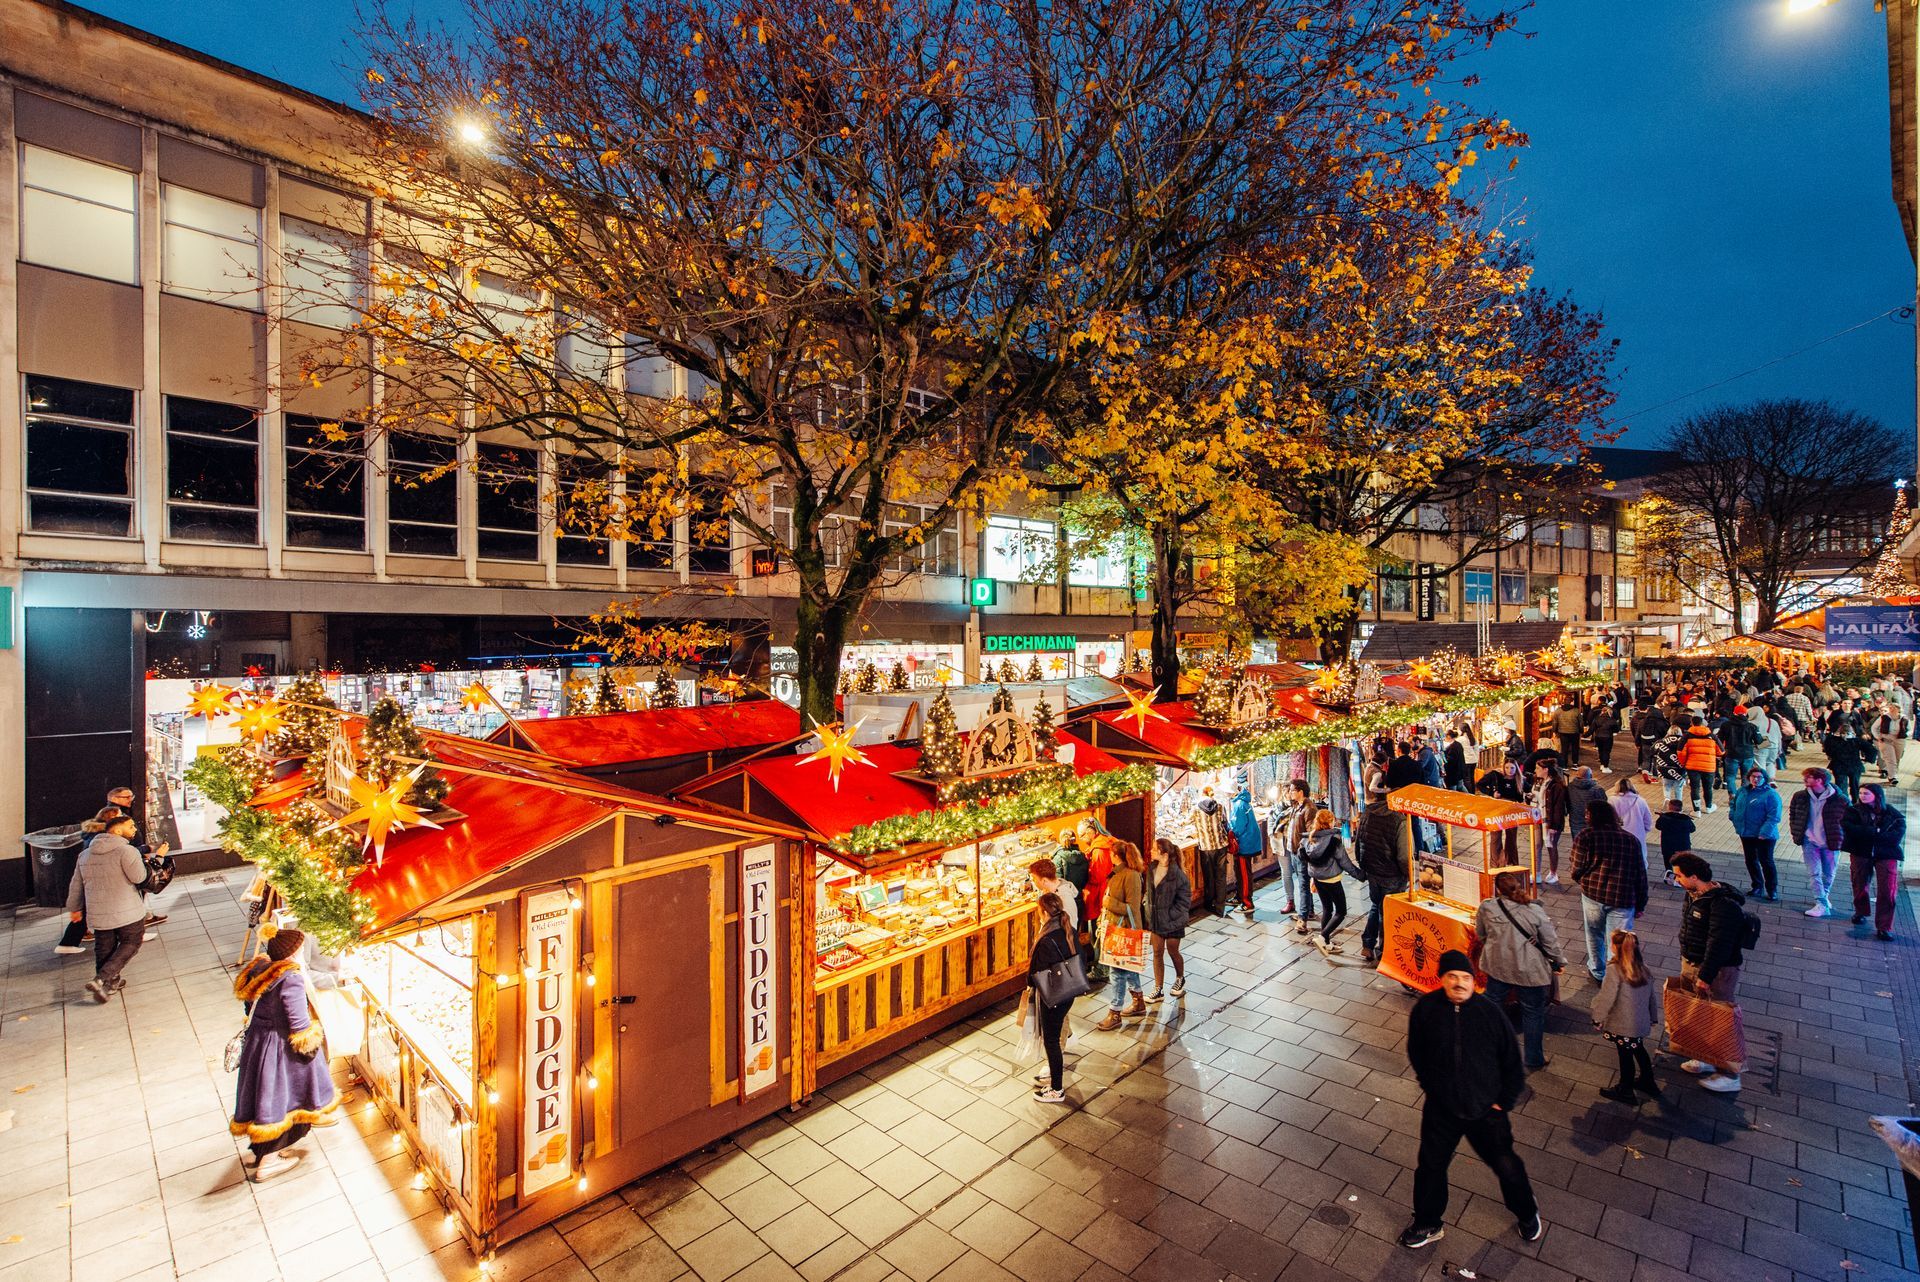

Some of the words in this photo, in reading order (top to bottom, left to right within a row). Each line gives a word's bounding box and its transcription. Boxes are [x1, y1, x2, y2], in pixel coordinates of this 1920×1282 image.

[756, 560, 775, 574] hmv
[975, 583, 990, 601] D
[1421, 578, 1430, 618] Martens
[1828, 623, 1920, 635] HALIFAX
[986, 635, 1076, 651] DEICHMANN
[1391, 796, 1403, 807] LIP
[1404, 799, 1411, 807] &
[1411, 801, 1436, 815] BODY
[1437, 807, 1464, 818] BALM
[1485, 817, 1504, 826] RAW
[1505, 812, 1532, 822] HONEY
[534, 909, 567, 922] MILLY'S
[1393, 912, 1428, 933] AMAZING
[1429, 923, 1448, 950] BEES
[750, 881, 769, 1045] FUDGE
[1394, 948, 1404, 962] LIP
[1406, 968, 1429, 985] BODY
[535, 934, 563, 1135] FUDGE
